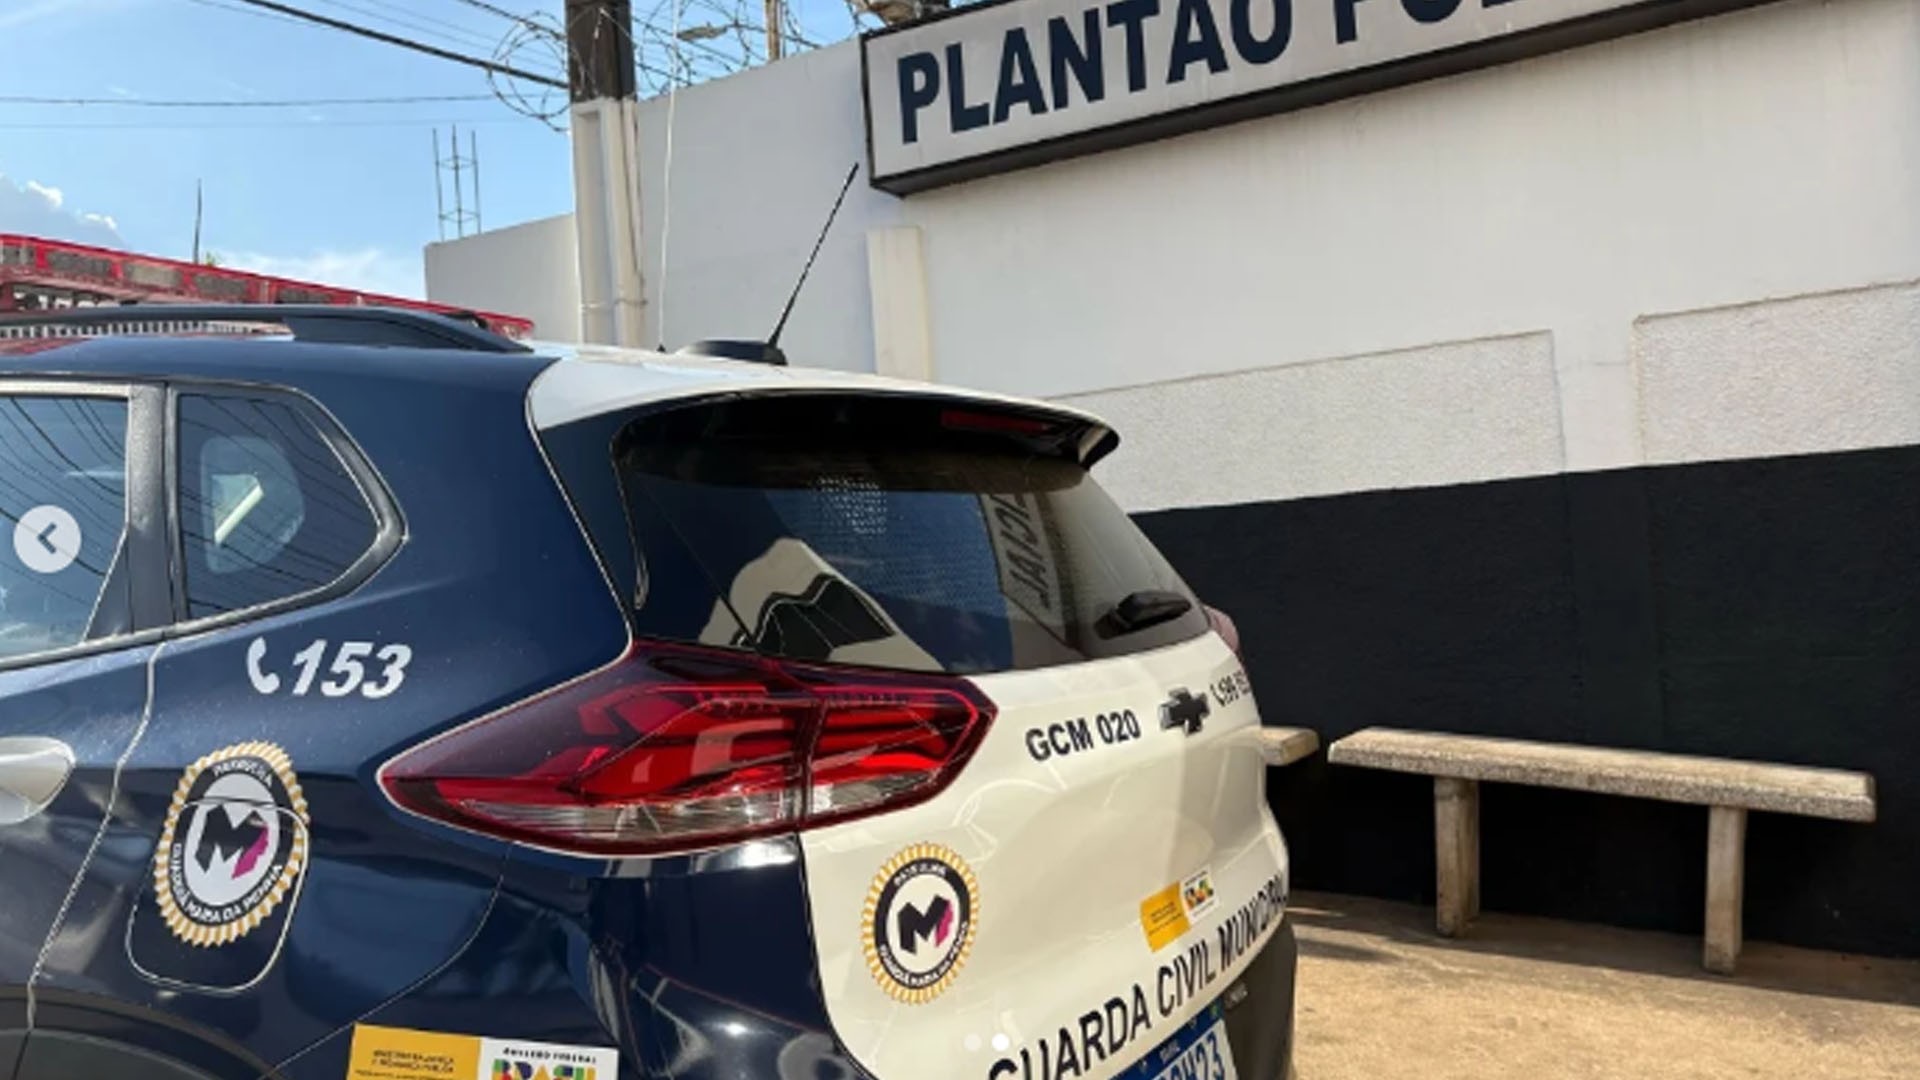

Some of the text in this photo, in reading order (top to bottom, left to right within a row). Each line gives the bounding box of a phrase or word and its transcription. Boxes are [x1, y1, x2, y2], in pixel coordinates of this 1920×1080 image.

[292, 638, 413, 698] 153
[1025, 708, 1141, 761] GCM 020
[1156, 938, 1217, 1018] CIVIL
